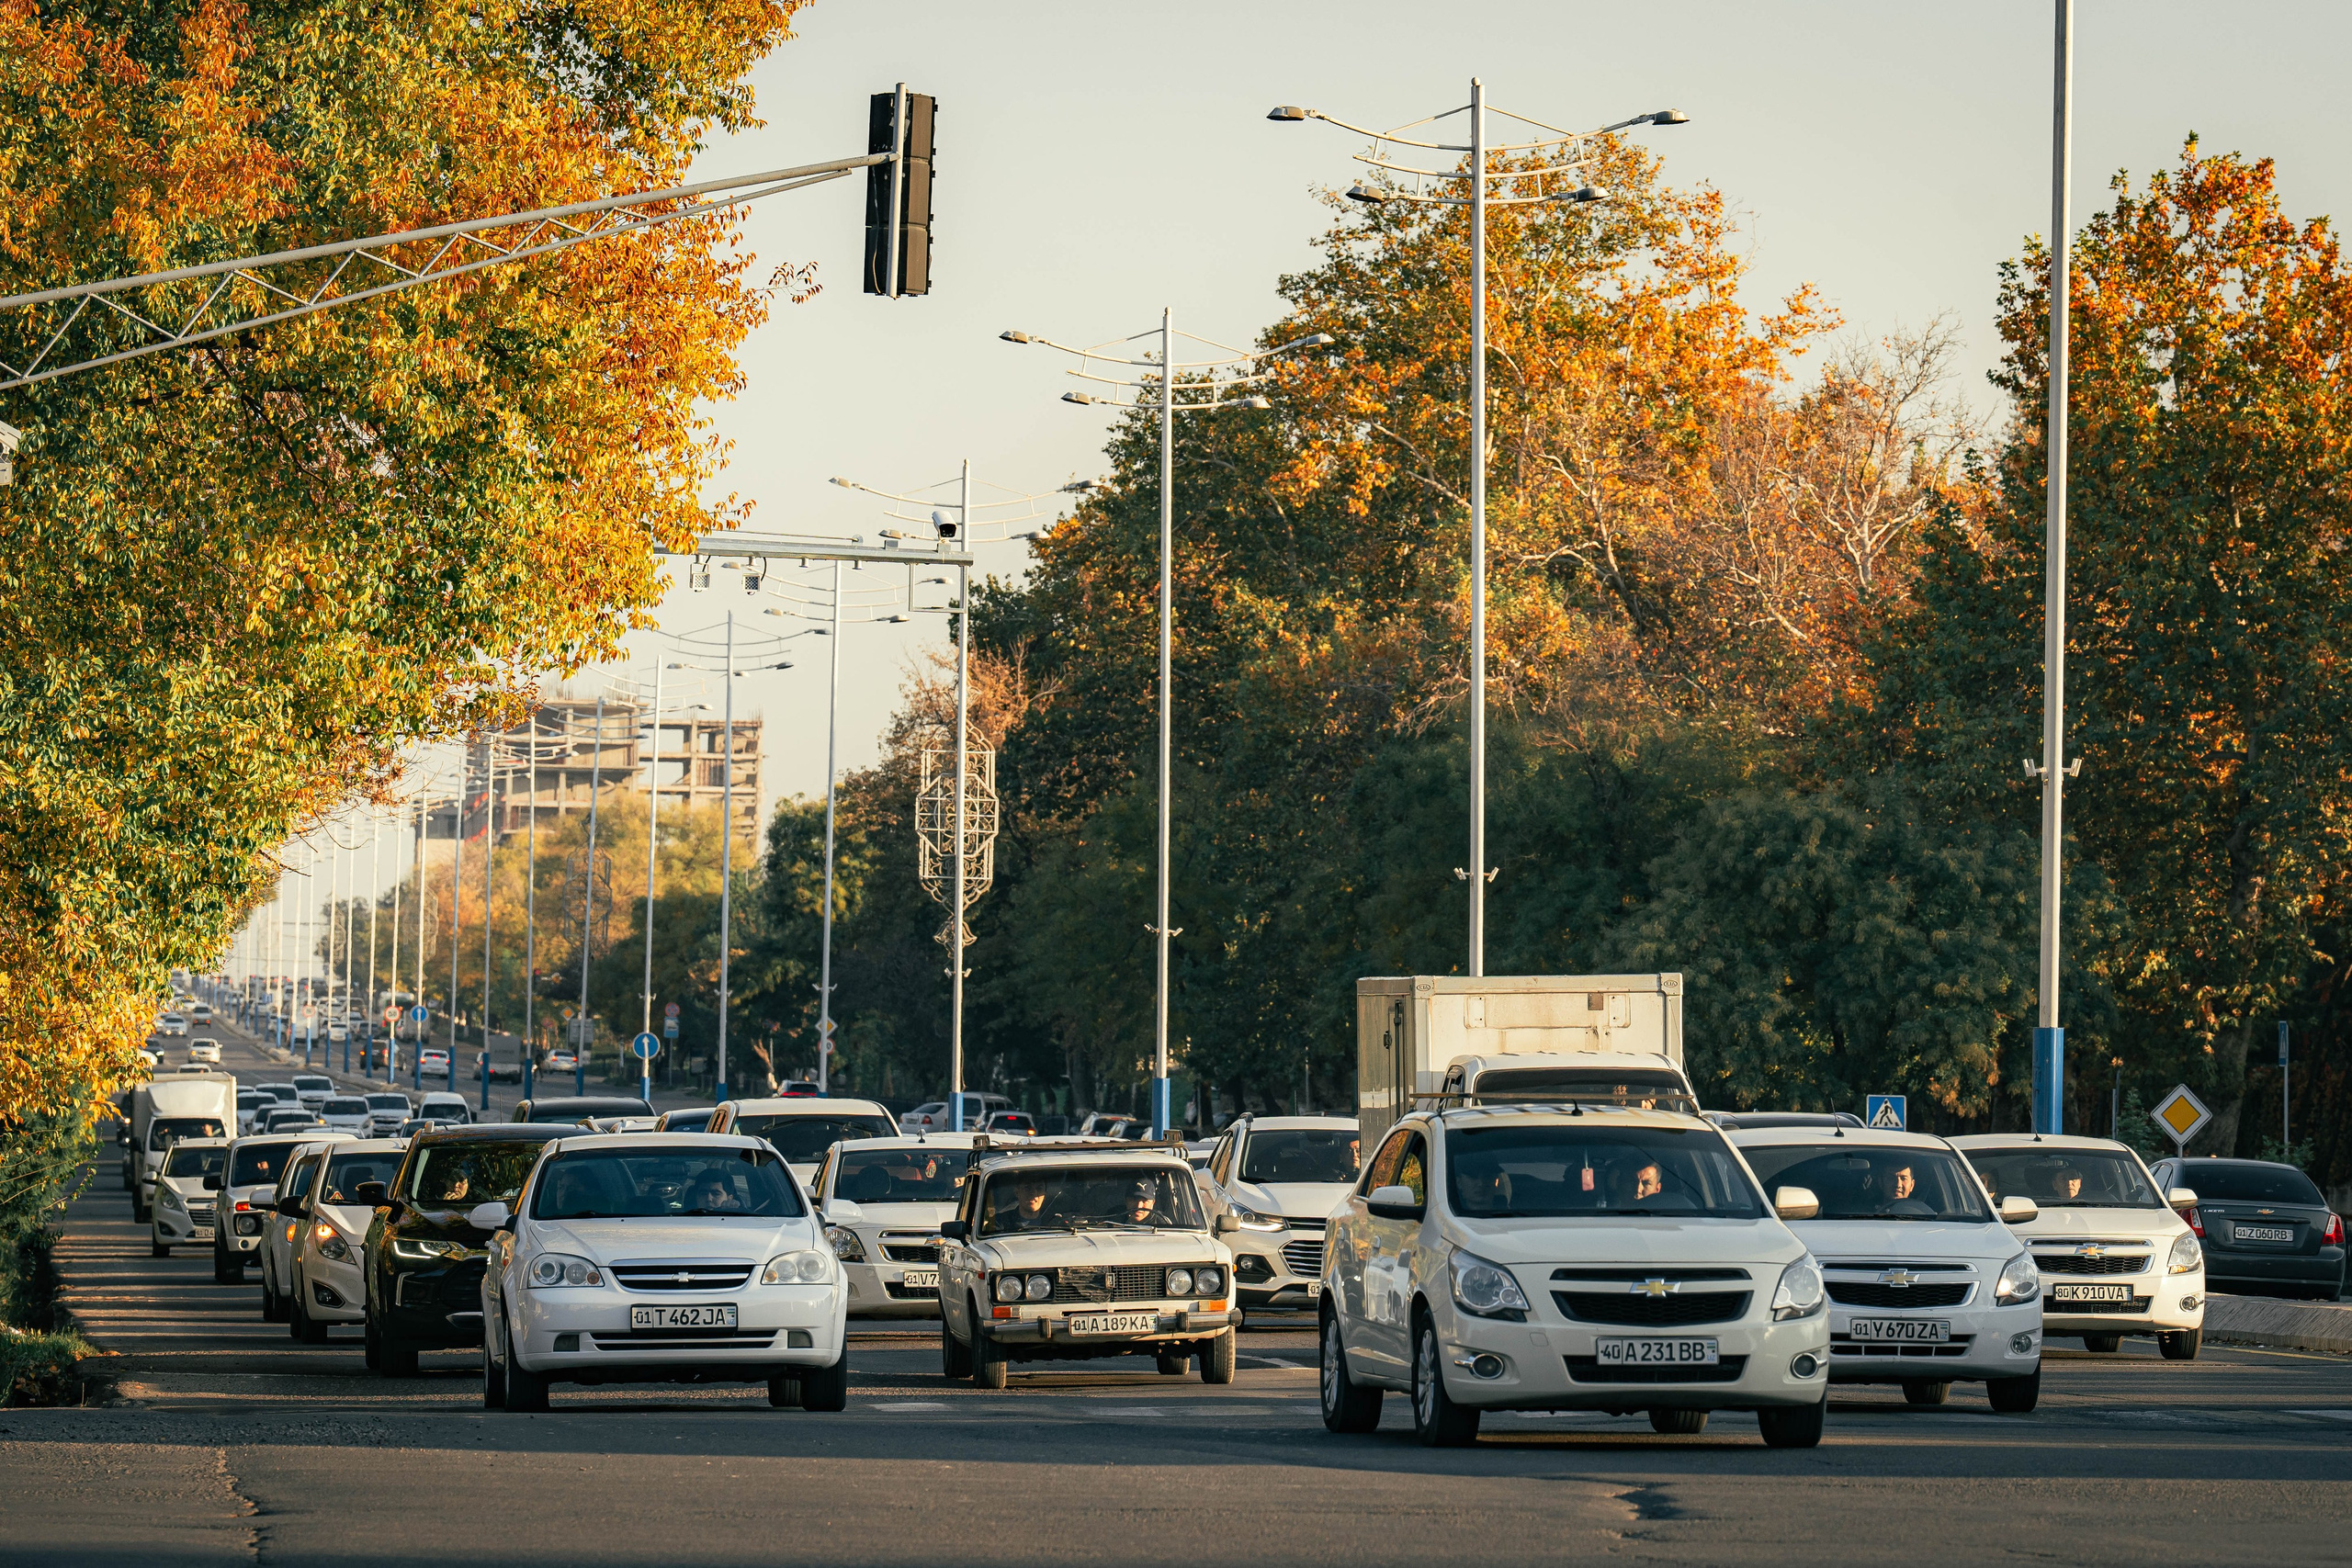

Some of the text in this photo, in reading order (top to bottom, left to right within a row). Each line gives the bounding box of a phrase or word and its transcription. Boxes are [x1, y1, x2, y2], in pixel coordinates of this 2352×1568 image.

[907, 1274, 918, 1284] 01
[2057, 1288, 2069, 1298] 80
[636, 1311, 651, 1324] 01
[1074, 1320, 1087, 1331] 01
[1855, 1323, 1870, 1336] 01
[1602, 1344, 1621, 1359] 40
